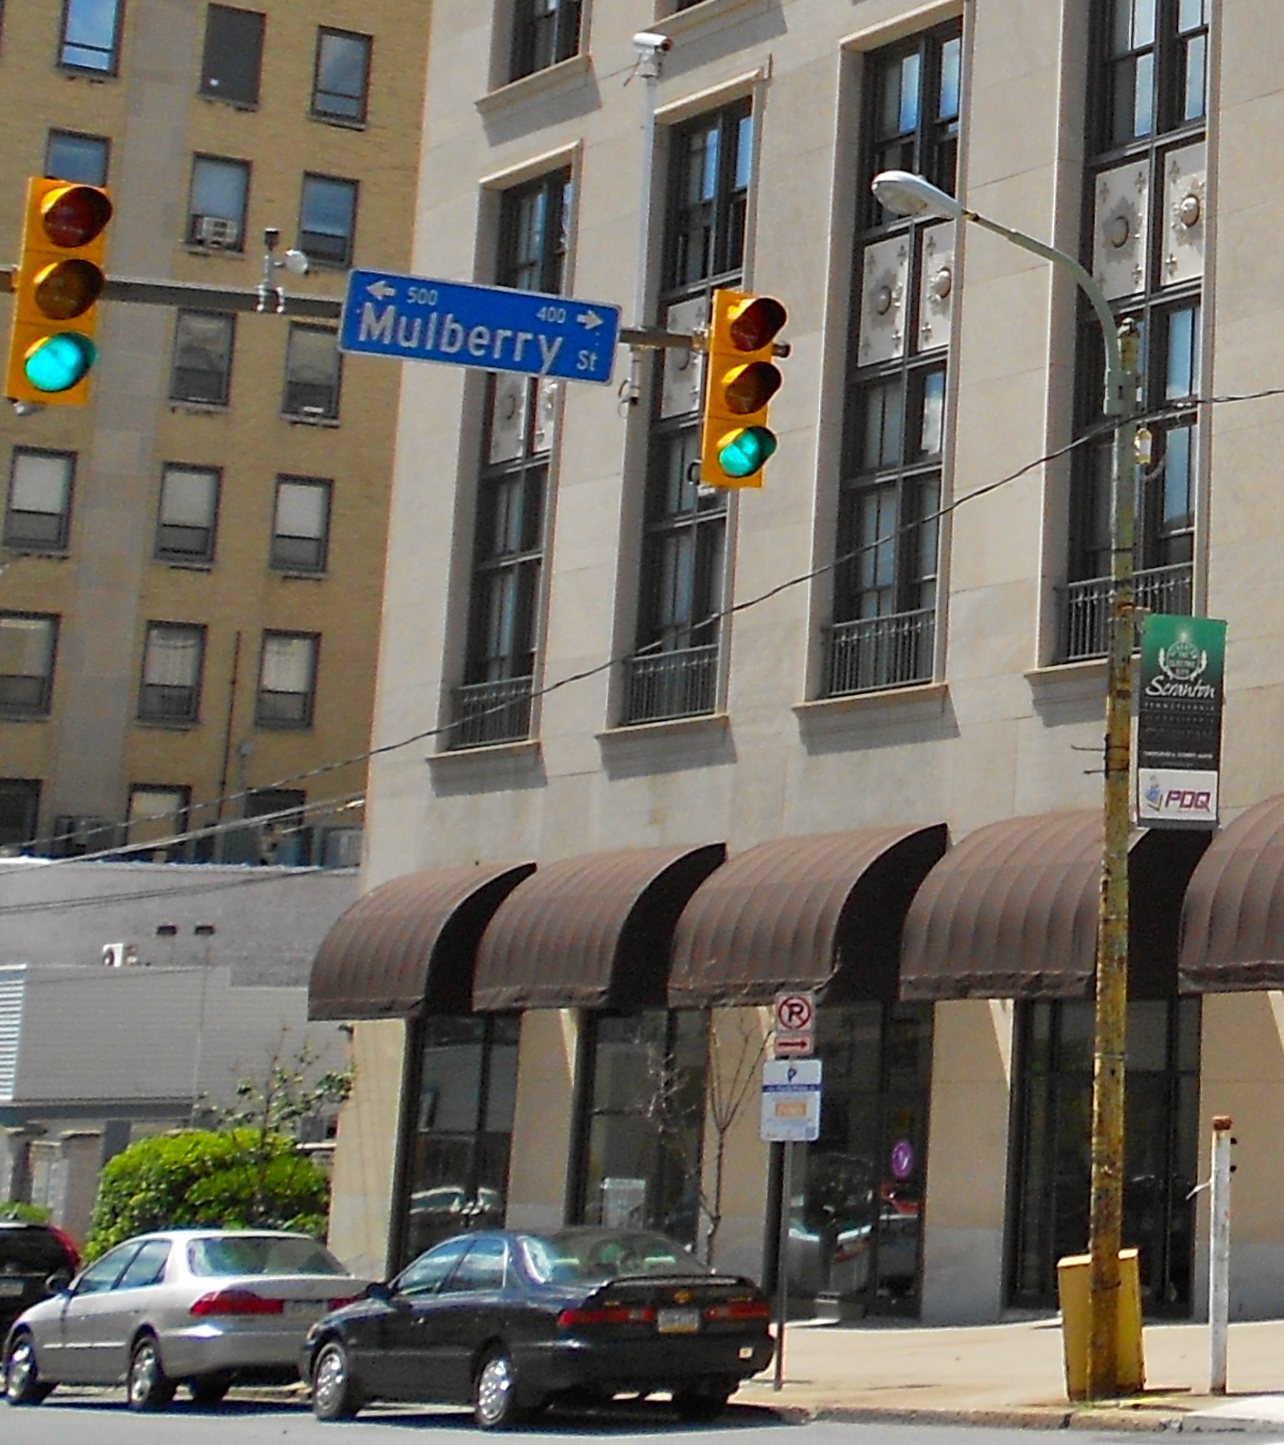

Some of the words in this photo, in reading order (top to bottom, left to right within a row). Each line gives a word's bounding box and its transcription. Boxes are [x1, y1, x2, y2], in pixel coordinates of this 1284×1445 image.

[406, 286, 438, 306] 500
[535, 306, 566, 325] 400
[357, 301, 563, 375] Mulberry
[576, 349, 598, 372] St
[1145, 675, 1216, 699] Scranton
[1165, 790, 1211, 812] PDQ
